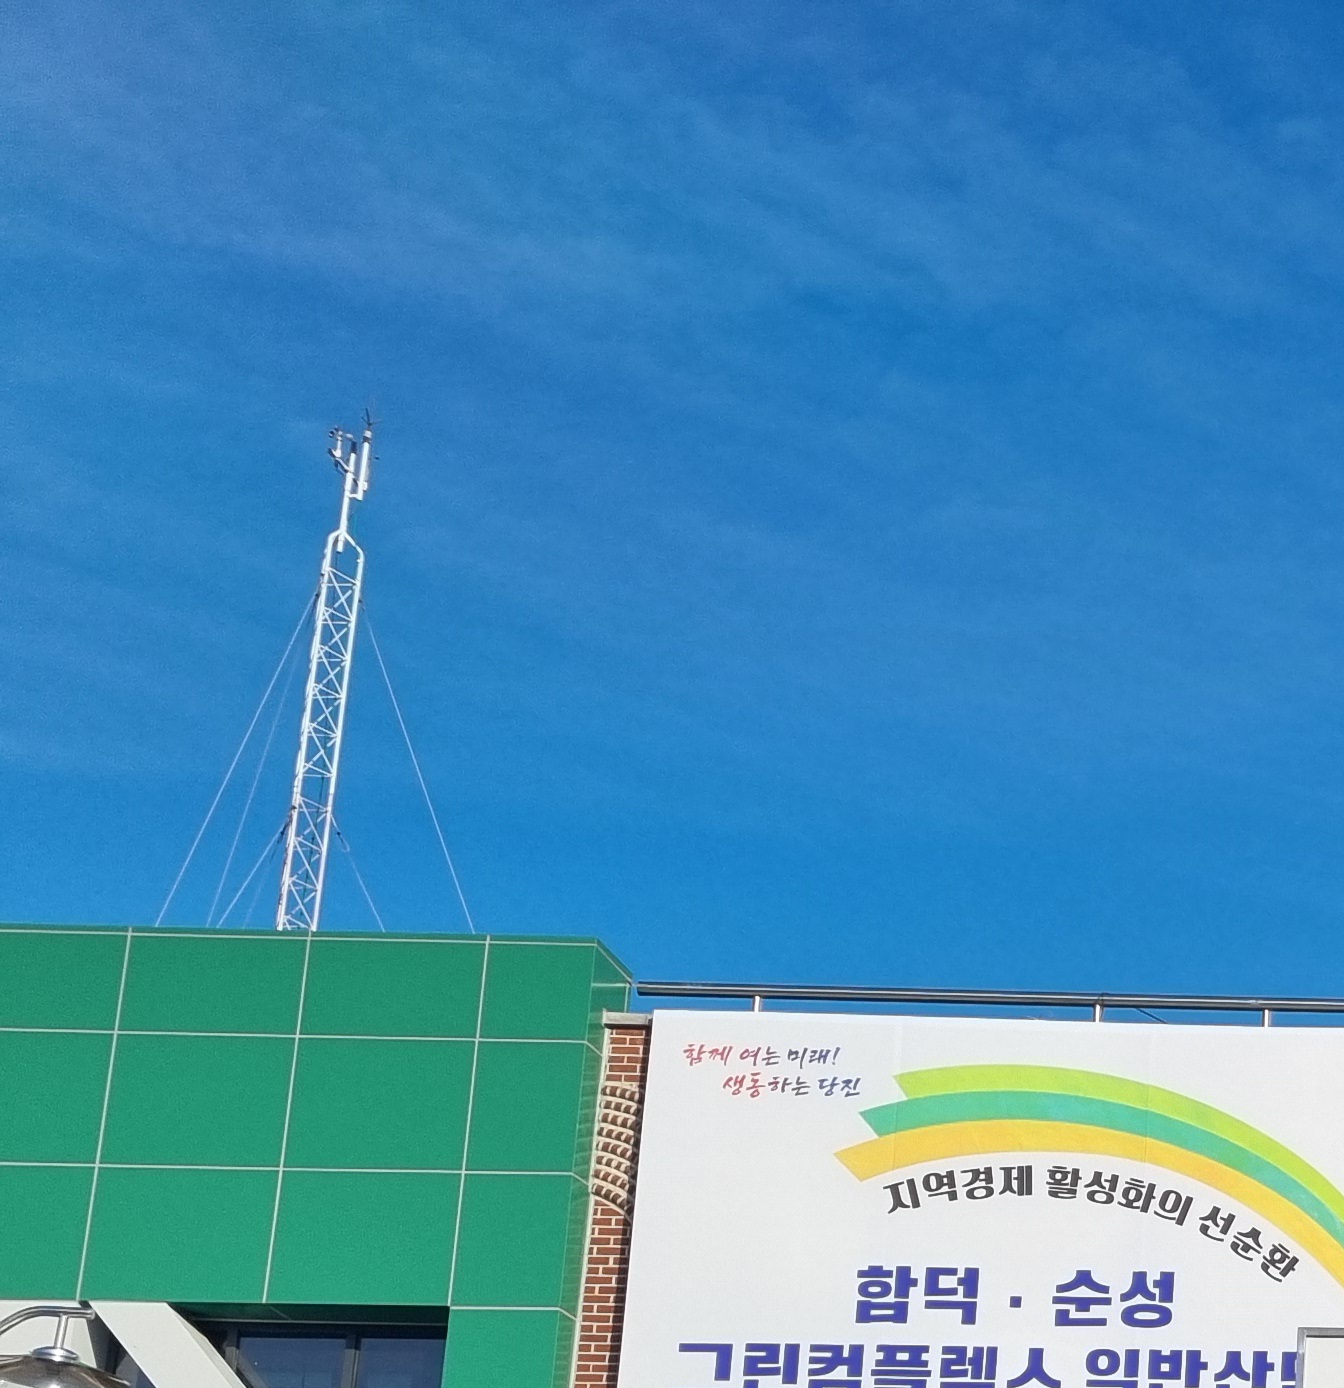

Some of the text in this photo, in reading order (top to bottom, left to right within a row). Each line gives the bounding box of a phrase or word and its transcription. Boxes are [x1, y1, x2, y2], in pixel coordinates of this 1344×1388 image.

[682, 1043, 841, 1070] 함께 여는 미래!
[722, 1072, 862, 1099] 생동하는 당진
[882, 1164, 1301, 1284] 지역경제 활성화의 선순환
[855, 1265, 980, 1326] 합덕
[1051, 1269, 1176, 1329] 순성
